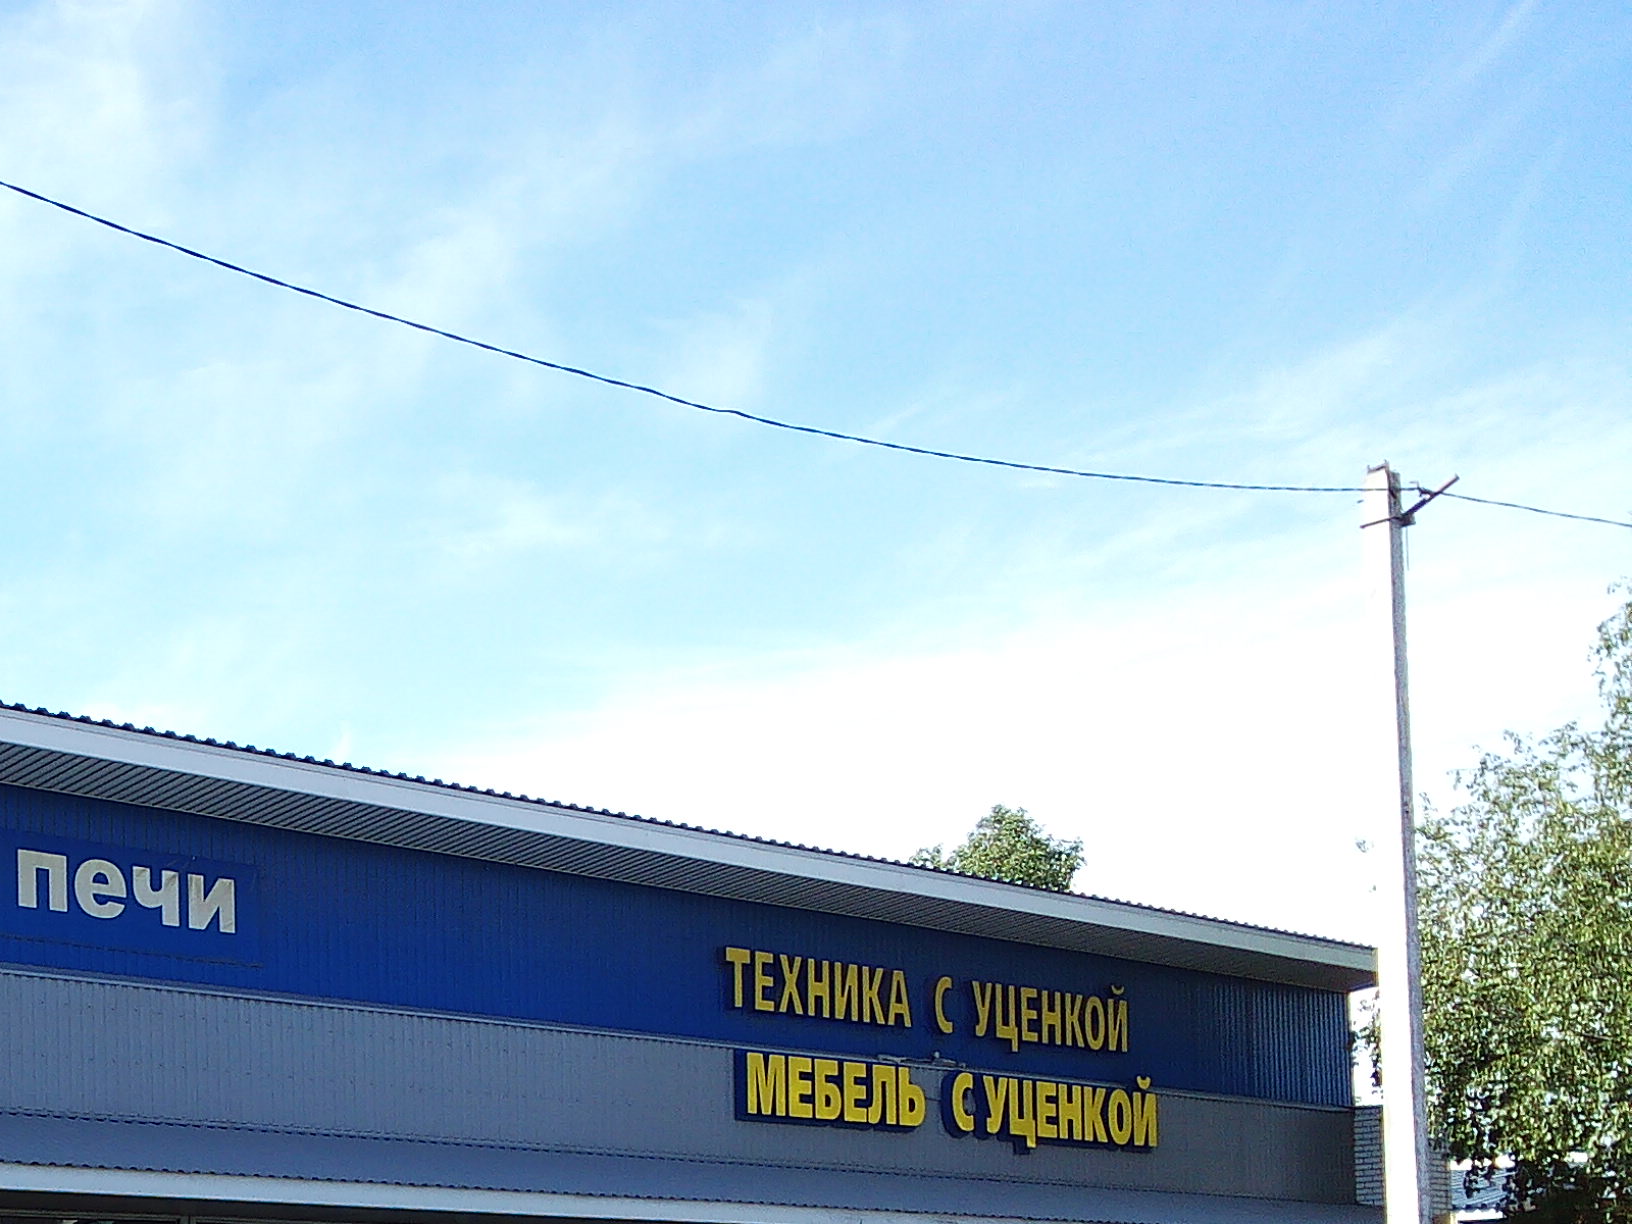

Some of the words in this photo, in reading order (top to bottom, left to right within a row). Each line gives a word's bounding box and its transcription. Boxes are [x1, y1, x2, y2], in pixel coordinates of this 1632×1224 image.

[16, 847, 237, 935] печи
[725, 947, 912, 1028] ТЕХНИКА
[935, 976, 954, 1033] С
[972, 980, 1129, 1053] УЦЕНКОЙ
[746, 1052, 927, 1127] МЕБЕЛЬ
[951, 1073, 974, 1131] С
[983, 1075, 1158, 1148] УЦЕНКОЙ
